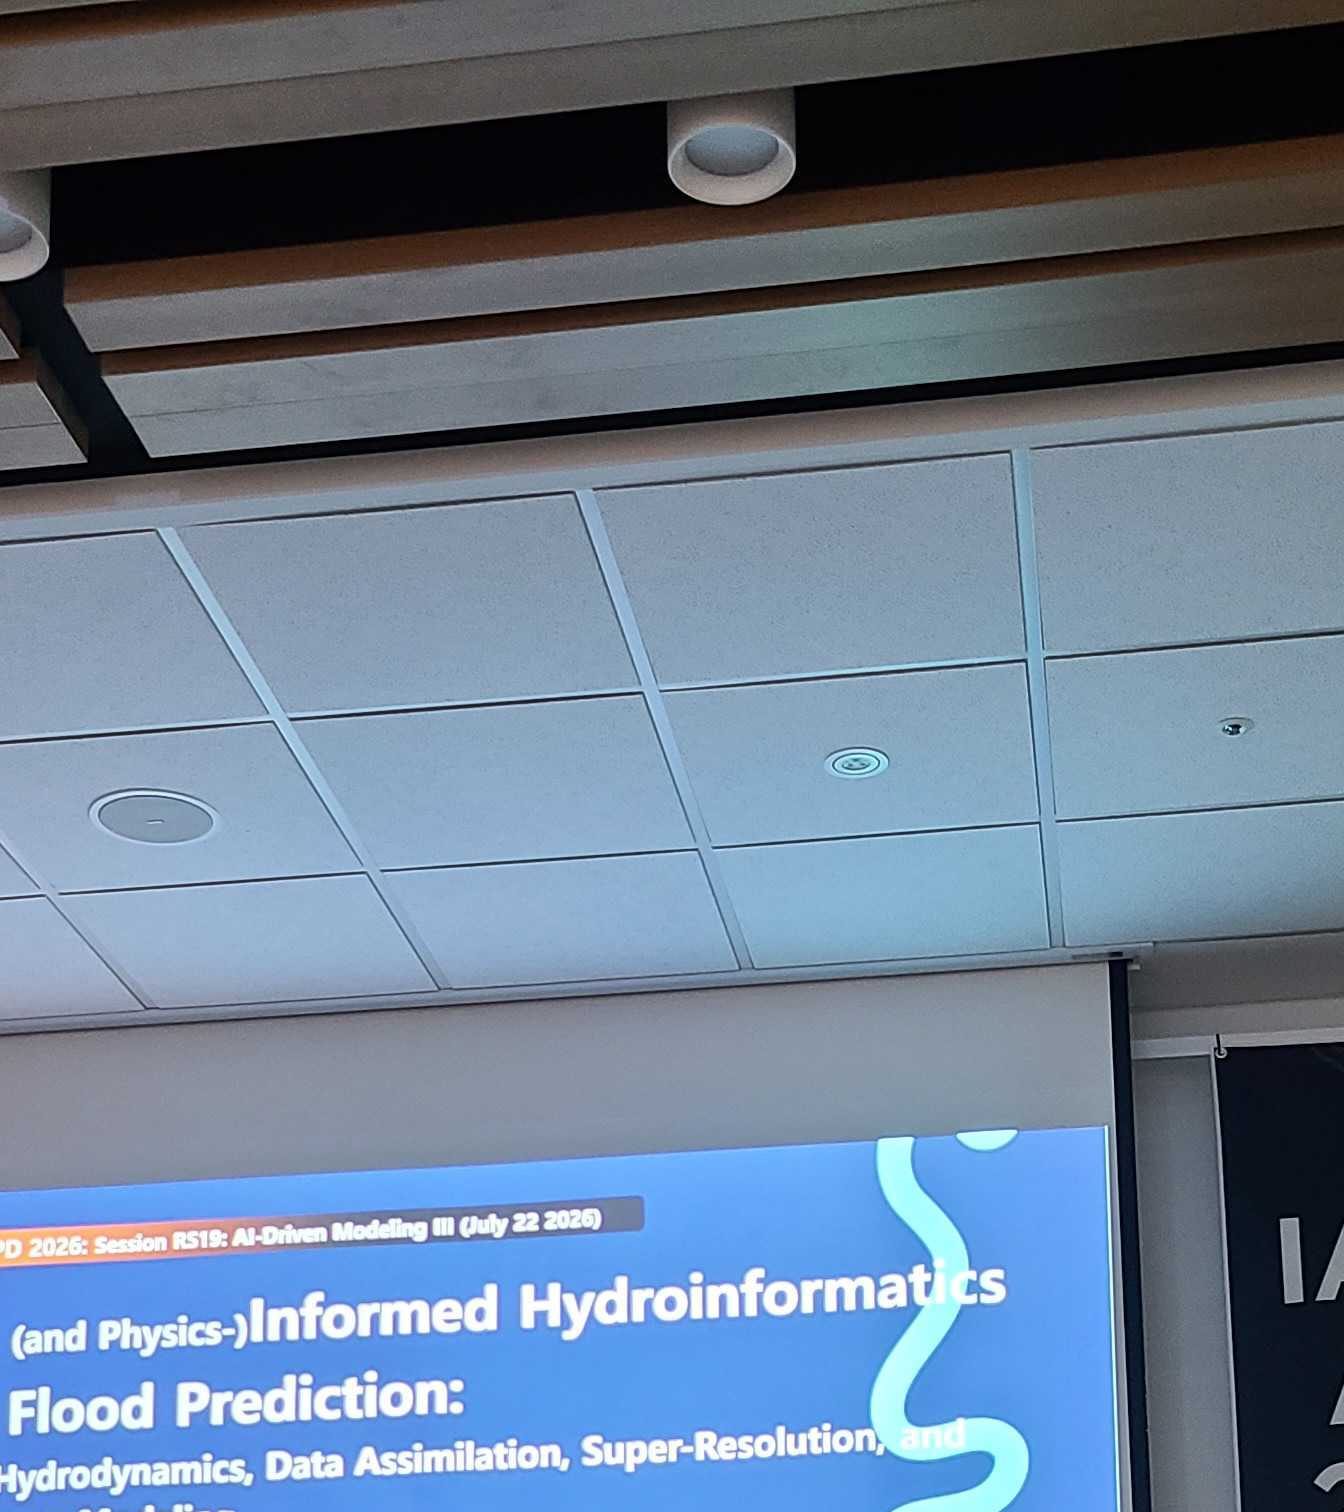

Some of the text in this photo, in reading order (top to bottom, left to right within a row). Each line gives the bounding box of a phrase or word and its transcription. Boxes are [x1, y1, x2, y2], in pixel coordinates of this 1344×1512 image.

[30, 1234, 88, 1258] 2026:
[94, 1232, 167, 1254] Session
[173, 1229, 227, 1250] RS19:
[232, 1223, 326, 1247] AI-Driven
[331, 1217, 428, 1243] Modeling
[433, 1216, 454, 1237] III
[460, 1212, 509, 1238] (July
[513, 1211, 539, 1232] 22
[544, 1208, 602, 1231] 2026)
[11, 1315, 86, 1360] (and
[520, 1258, 1007, 1341] Hydroinformatics
[8, 1383, 155, 1436] Flood
[176, 1369, 465, 1428] Prediction:
[265, 1450, 344, 1482] Data
[353, 1437, 570, 1478] Assimilation,
[582, 1422, 887, 1473] Super-Resolution,
[900, 1417, 966, 1451] and
